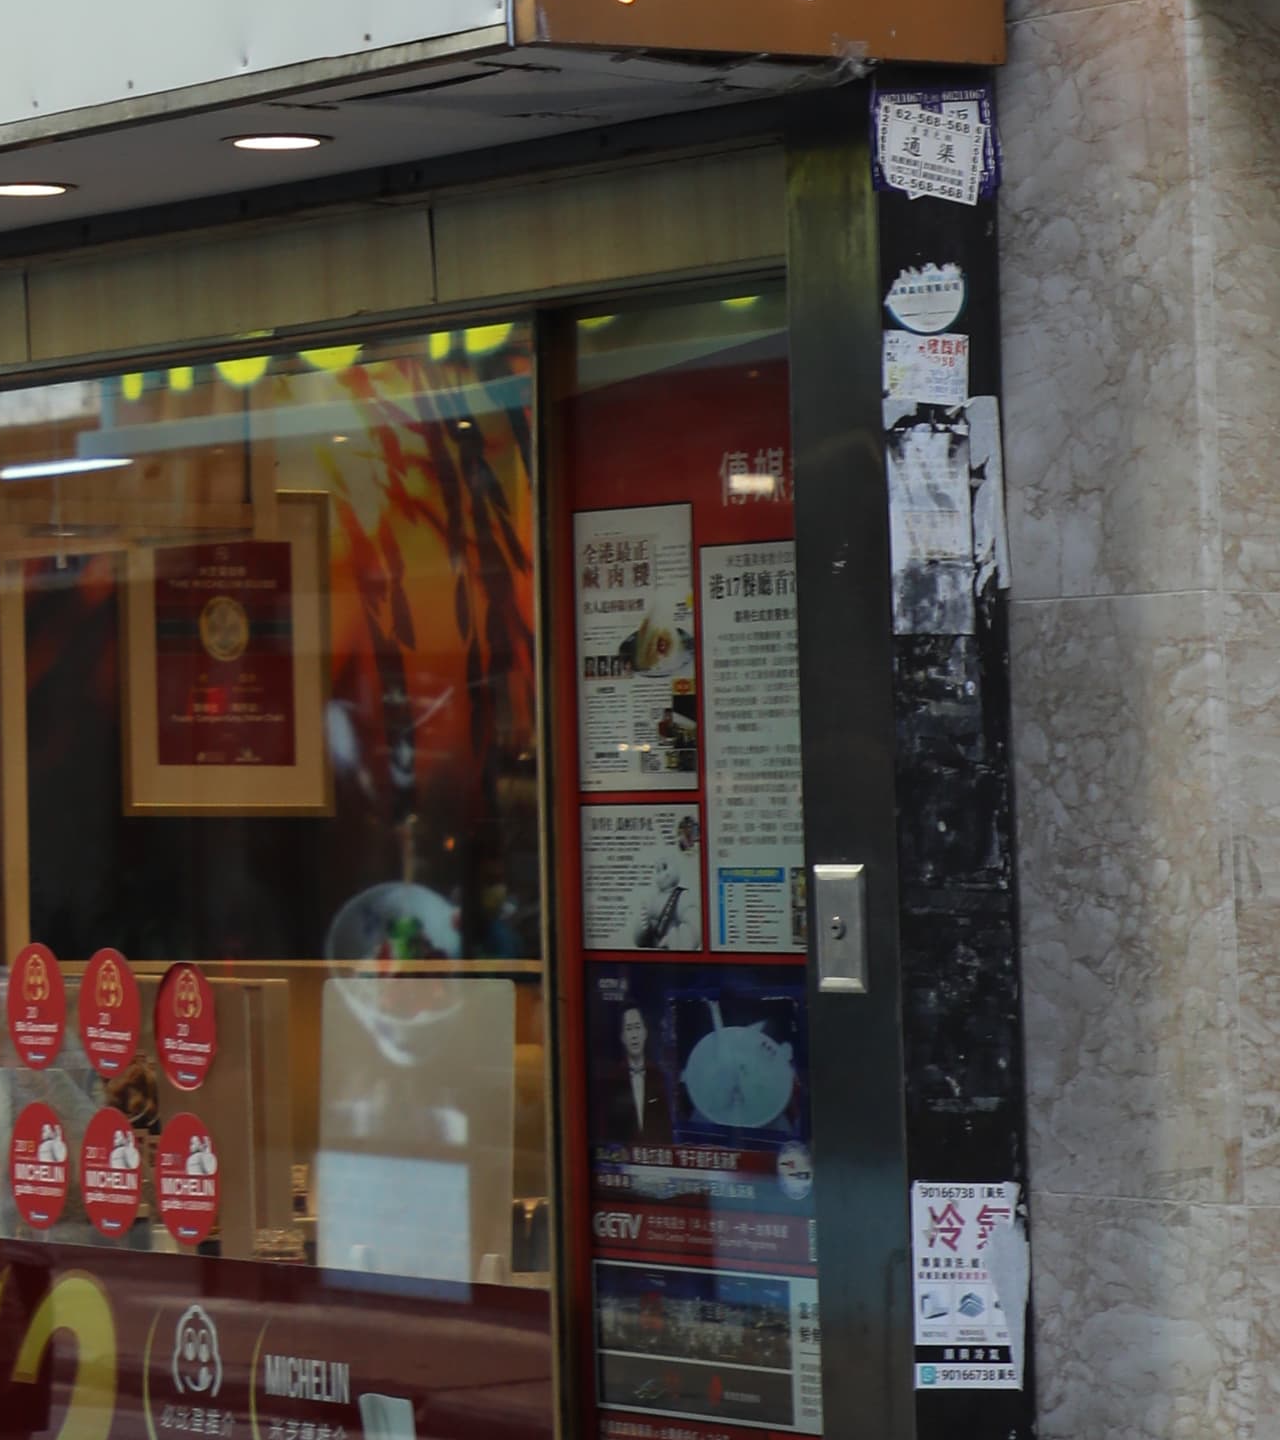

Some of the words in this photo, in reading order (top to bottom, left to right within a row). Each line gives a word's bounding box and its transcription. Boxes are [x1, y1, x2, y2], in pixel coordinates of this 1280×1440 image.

[896, 108, 971, 134] 62-568-568
[890, 173, 964, 199] 62-568-568
[719, 446, 794, 507] 傳媒
[920, 1187, 975, 1199] 90166738
[593, 1211, 643, 1240] CCTV
[264, 1354, 350, 1404] MICHELIN
[941, 1369, 995, 1381] 90166738
